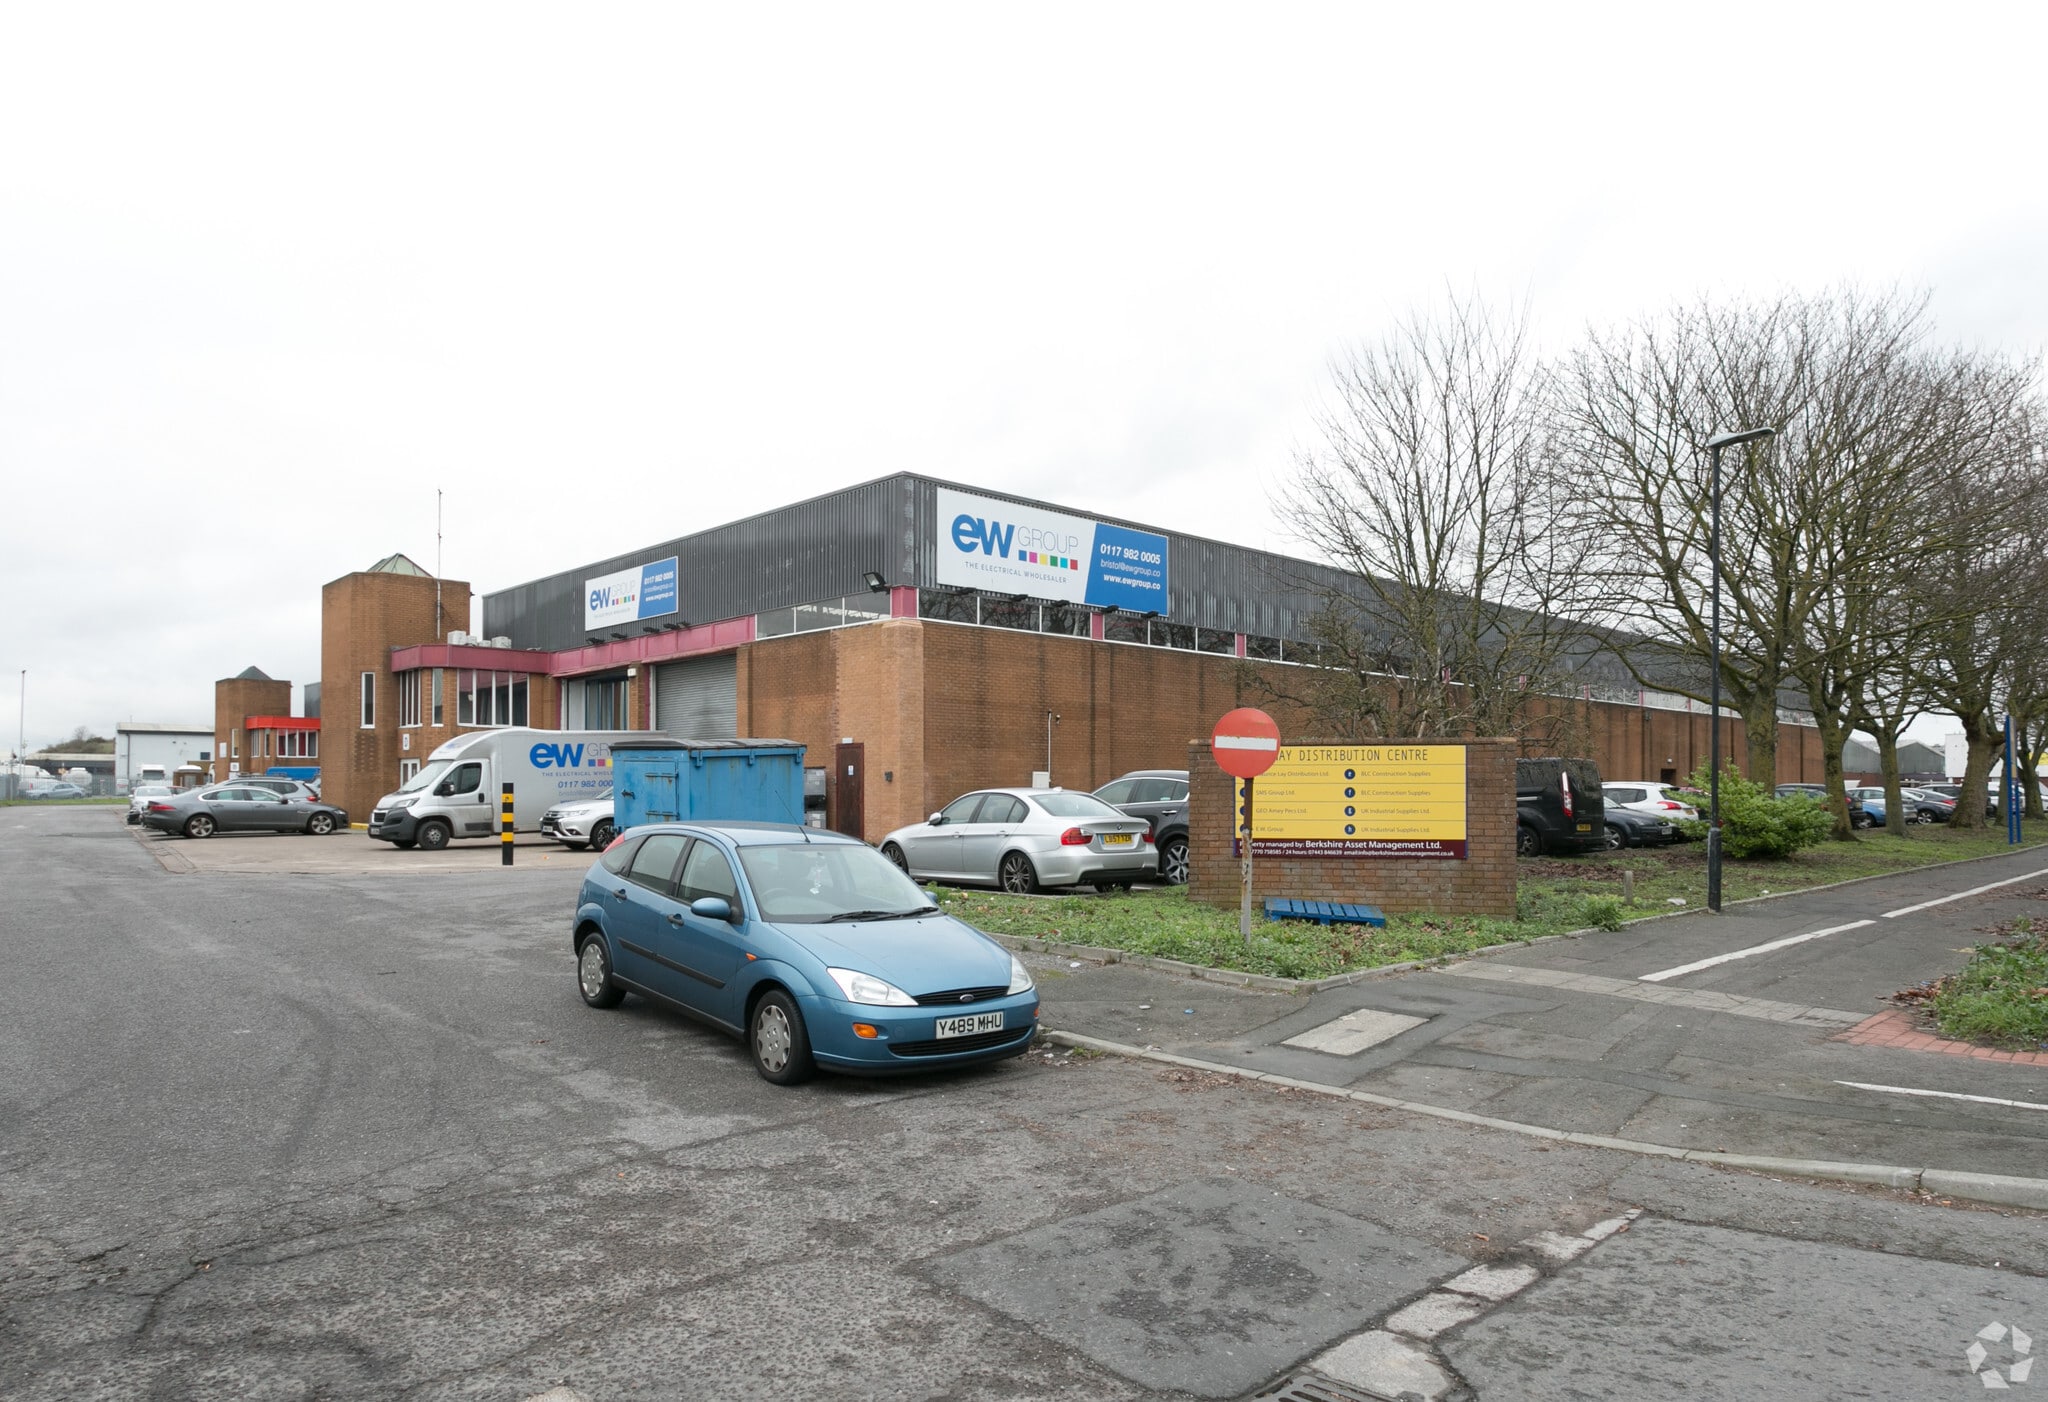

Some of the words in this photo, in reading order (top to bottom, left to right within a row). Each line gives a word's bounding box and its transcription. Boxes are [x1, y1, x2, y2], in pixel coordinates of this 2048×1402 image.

[1017, 525, 1079, 554] GROUP
[1100, 543, 1122, 557] 0117
[1123, 547, 1139, 561] 982
[1140, 551, 1161, 565] 0005
[965, 561, 979, 570] THE
[980, 564, 1021, 577] ELECTRICAL
[1024, 570, 1067, 583] WHOLESALER
[1100, 559, 1161, 577] bristol@ewgroup.co
[1103, 574, 1161, 590] www.ewgroup.co
[1277, 749, 1292, 761] AY
[1299, 749, 1380, 761] DISTRIBUTION
[1387, 749, 1429, 761] CENTRE
[558, 780, 579, 788] 0117
[1295, 841, 1305, 849] by:
[1305, 841, 1343, 849] Berkshire
[1345, 841, 1367, 849] Asset
[1368, 841, 1424, 851] Management
[1426, 841, 1442, 849] Ltd.
[938, 1018, 974, 1035] Y489
[977, 1014, 1002, 1030] MHU
